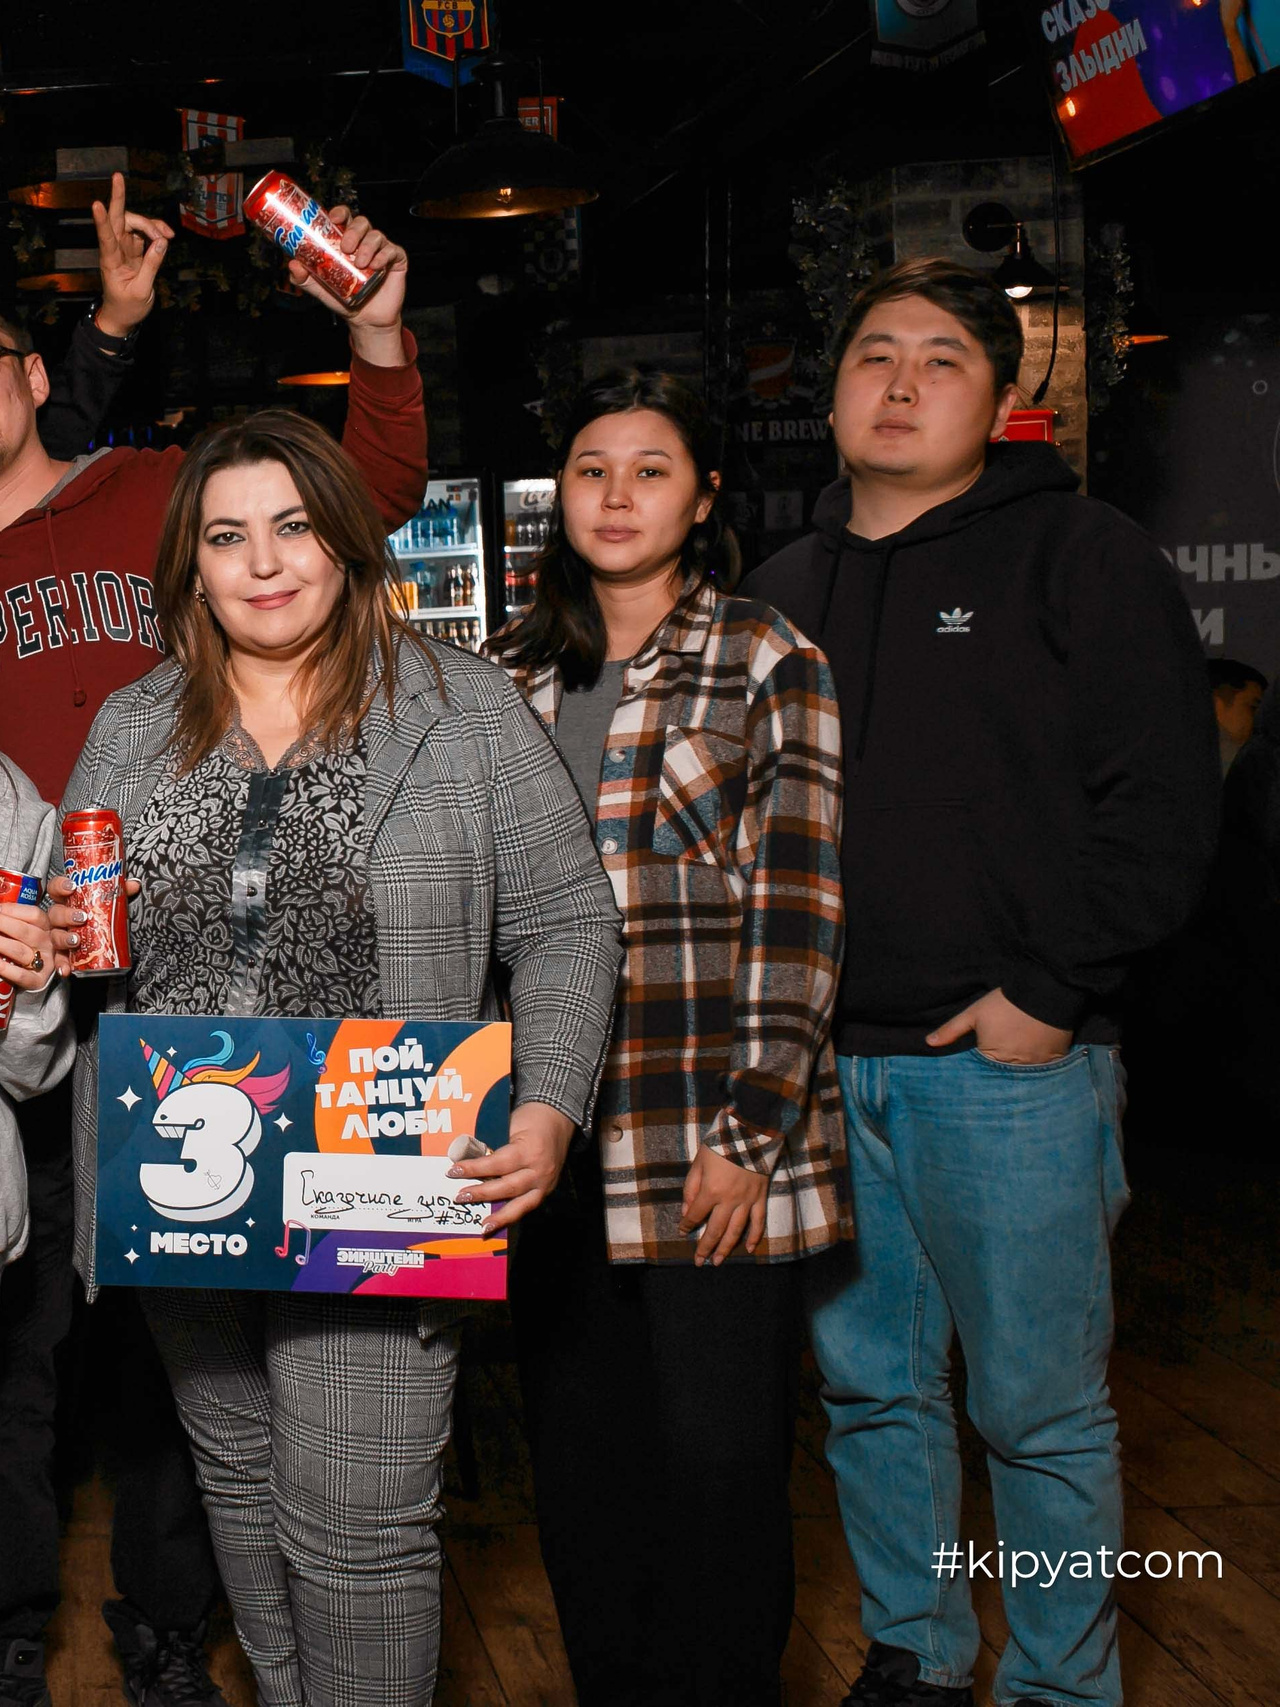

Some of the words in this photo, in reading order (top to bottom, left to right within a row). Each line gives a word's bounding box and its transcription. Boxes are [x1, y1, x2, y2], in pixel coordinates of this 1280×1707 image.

[437, 1, 459, 10] FCB
[1056, 18, 1148, 92] ЗЛЫДНИ
[936, 625, 971, 633] adidas
[348, 1038, 434, 1074] ПОЙ,
[315, 1068, 473, 1108] ТАНЦУЙ,
[341, 1108, 453, 1140] ЛЮБИ
[139, 1083, 263, 1222] 3
[310, 1213, 341, 1221] КОМАНДА
[150, 1231, 248, 1256] МЕСТО
[362, 1260, 400, 1277] Party
